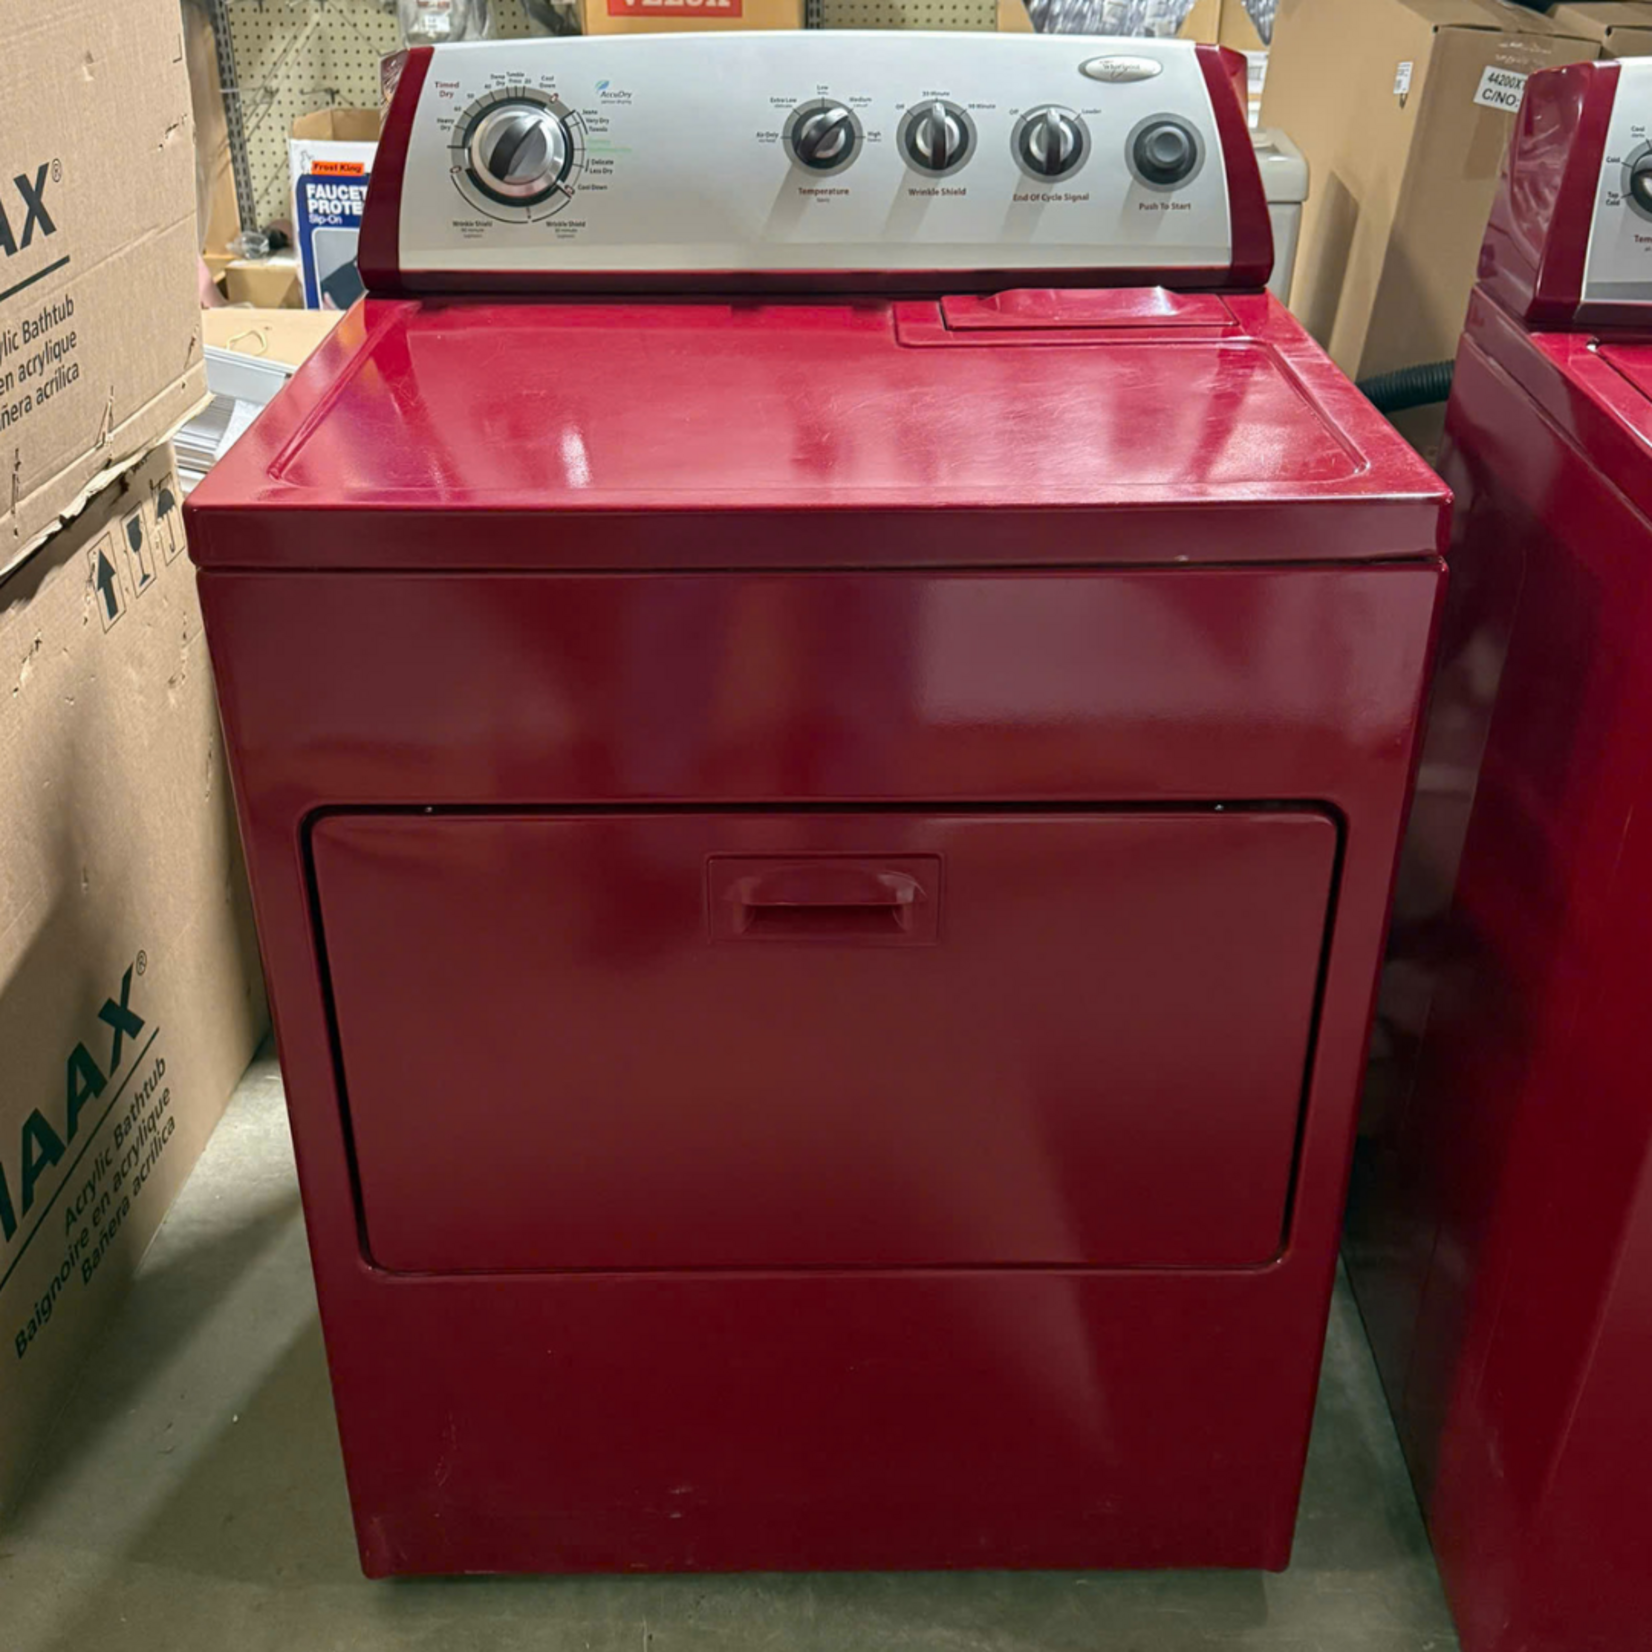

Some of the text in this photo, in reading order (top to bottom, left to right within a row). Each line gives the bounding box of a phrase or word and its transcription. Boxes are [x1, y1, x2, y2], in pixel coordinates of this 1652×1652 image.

[435, 81, 459, 89] Timed
[439, 90, 454, 98] Dry
[600, 91, 632, 99] AccuDry
[867, 131, 881, 139] High
[314, 163, 362, 173] Frost King
[306, 183, 368, 201] FAUCET
[798, 187, 849, 197] Temperature
[908, 187, 966, 196] Wrinkle Shield
[1013, 193, 1028, 201] End
[1041, 193, 1062, 203] Cycle
[1064, 193, 1090, 203] Signal
[1139, 202, 1191, 210] Push To Start
[308, 214, 343, 225] Slip-On
[22, 293, 75, 344] Bathtub
[18, 330, 78, 383] acrylique
[36, 362, 80, 406] acrílica
[64, 1056, 166, 1237] Acrylic Bathtub
[81, 1115, 175, 1285] Bañera acrílica
[14, 1087, 170, 1361] Baignoire en acrylique
